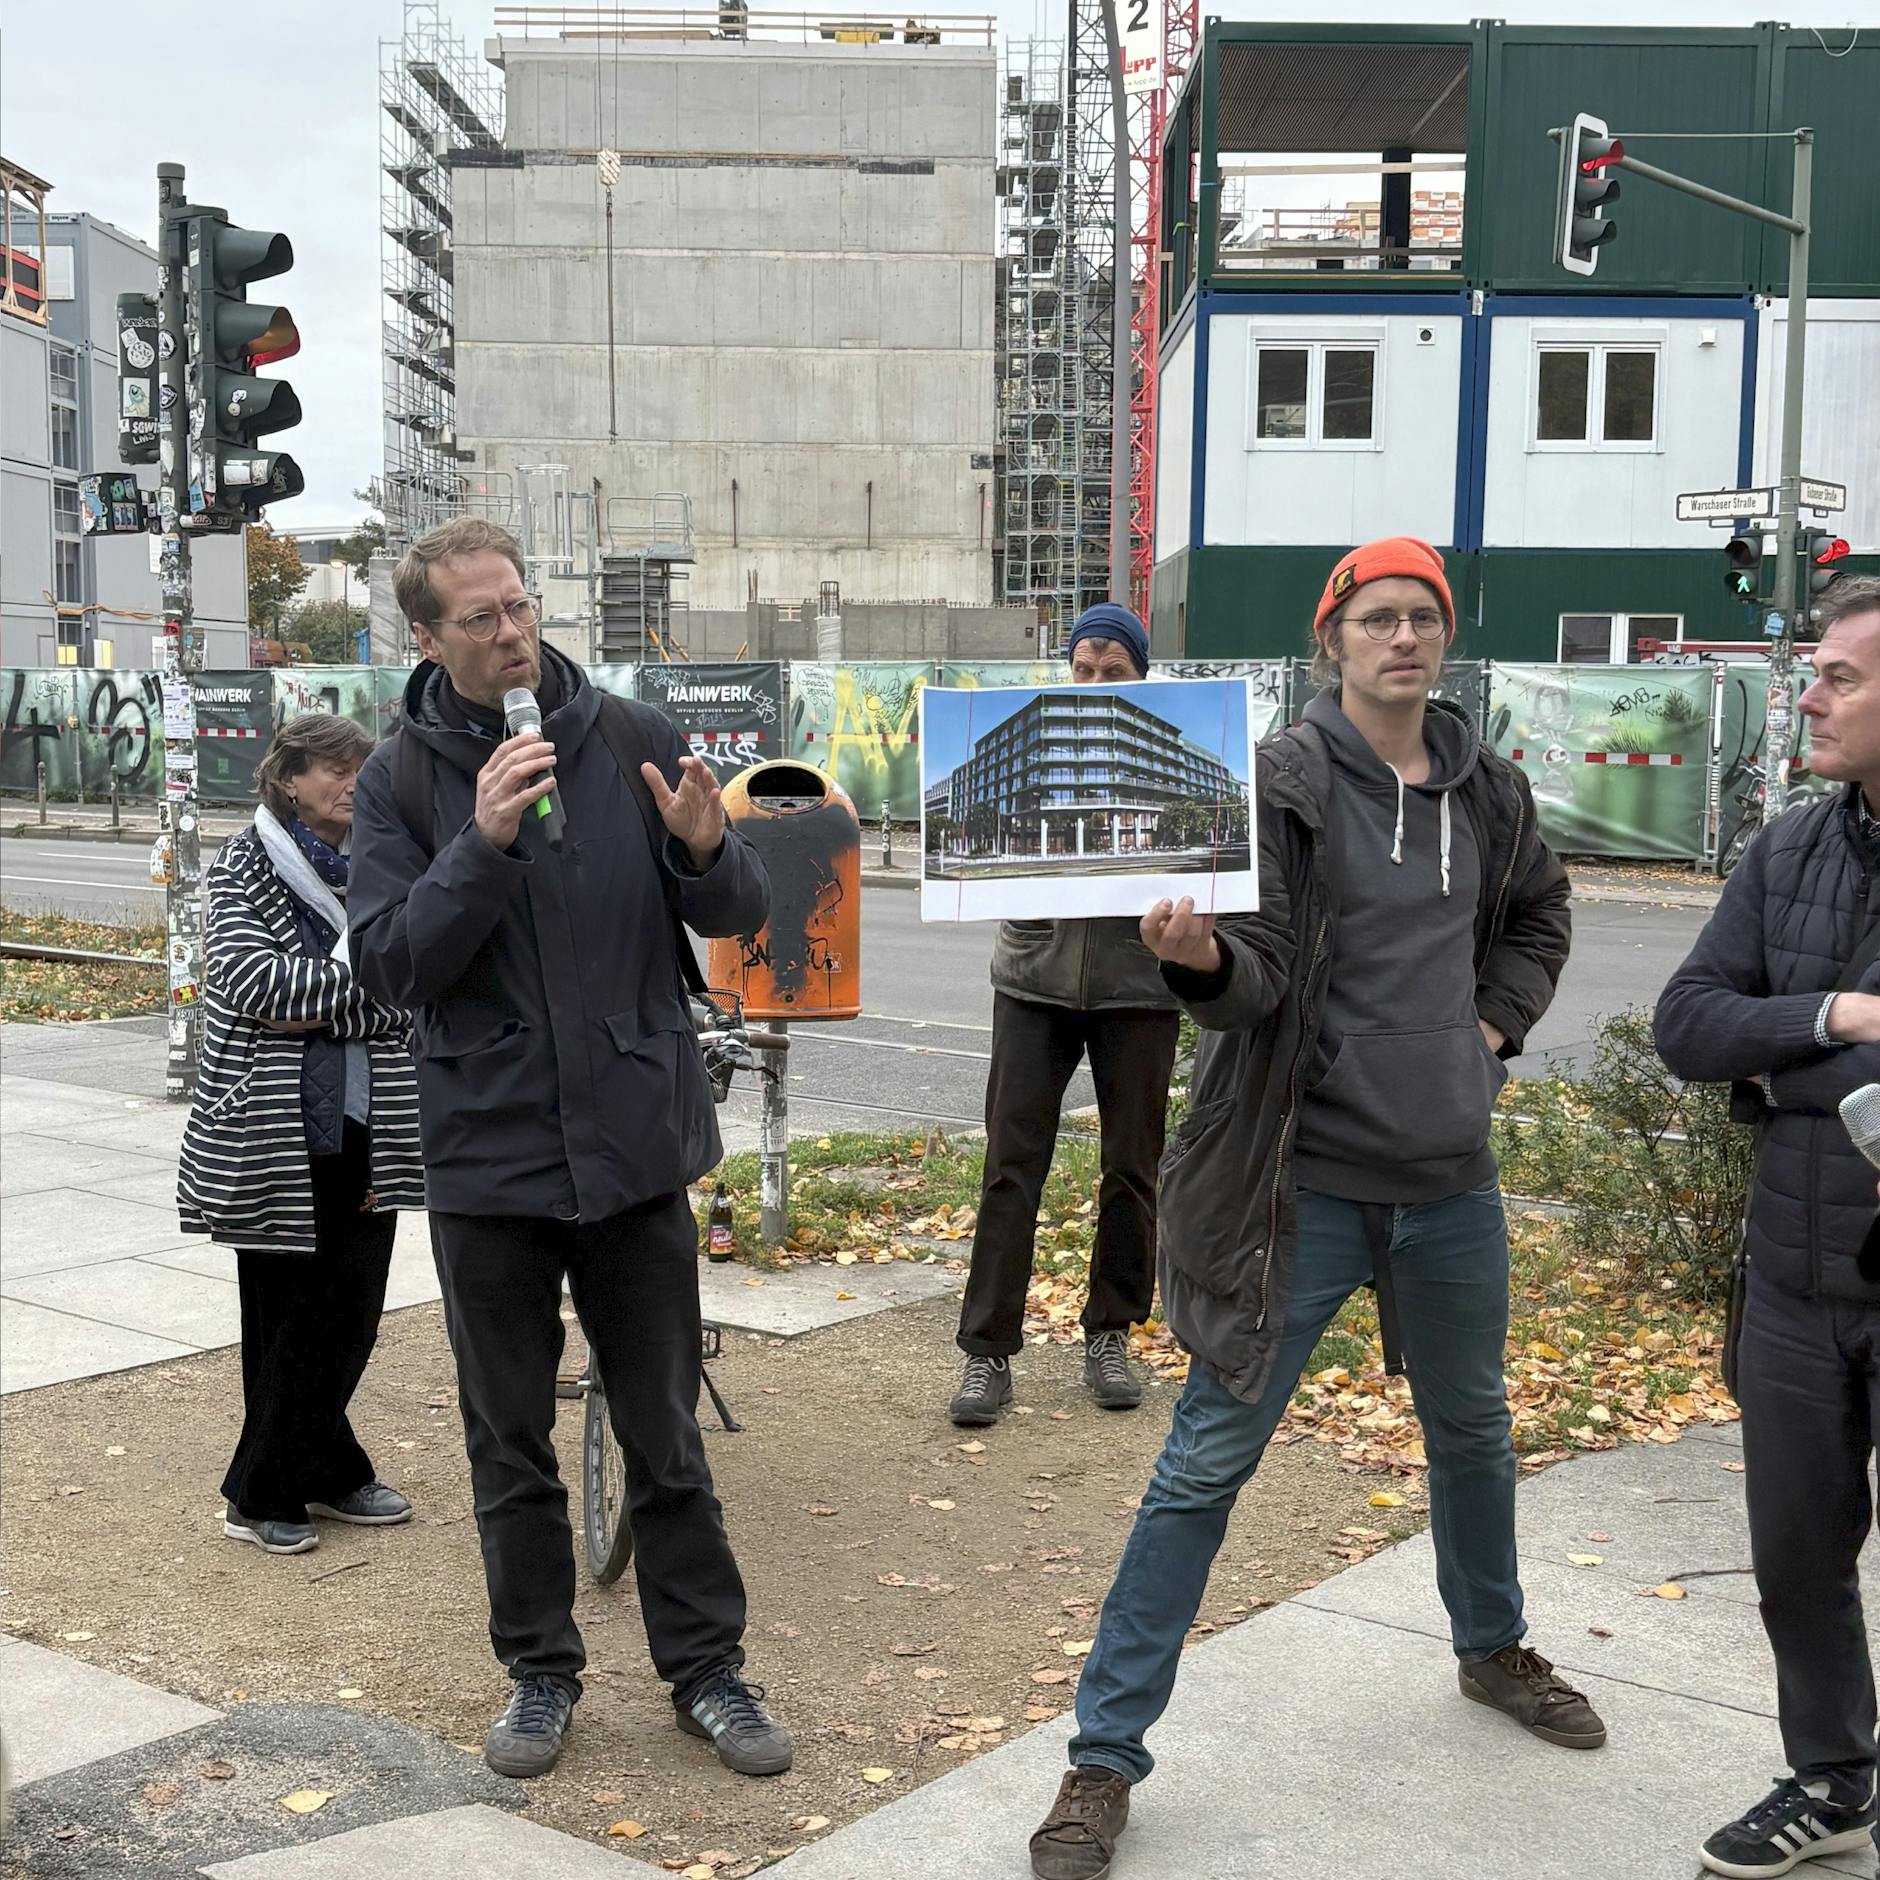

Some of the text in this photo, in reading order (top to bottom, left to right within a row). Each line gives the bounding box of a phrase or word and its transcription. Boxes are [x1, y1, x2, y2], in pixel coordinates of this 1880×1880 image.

[1127, 0, 1149, 33] 2
[1690, 496, 1756, 512] Warschauer Straße
[666, 685, 753, 703] HAINWERK
